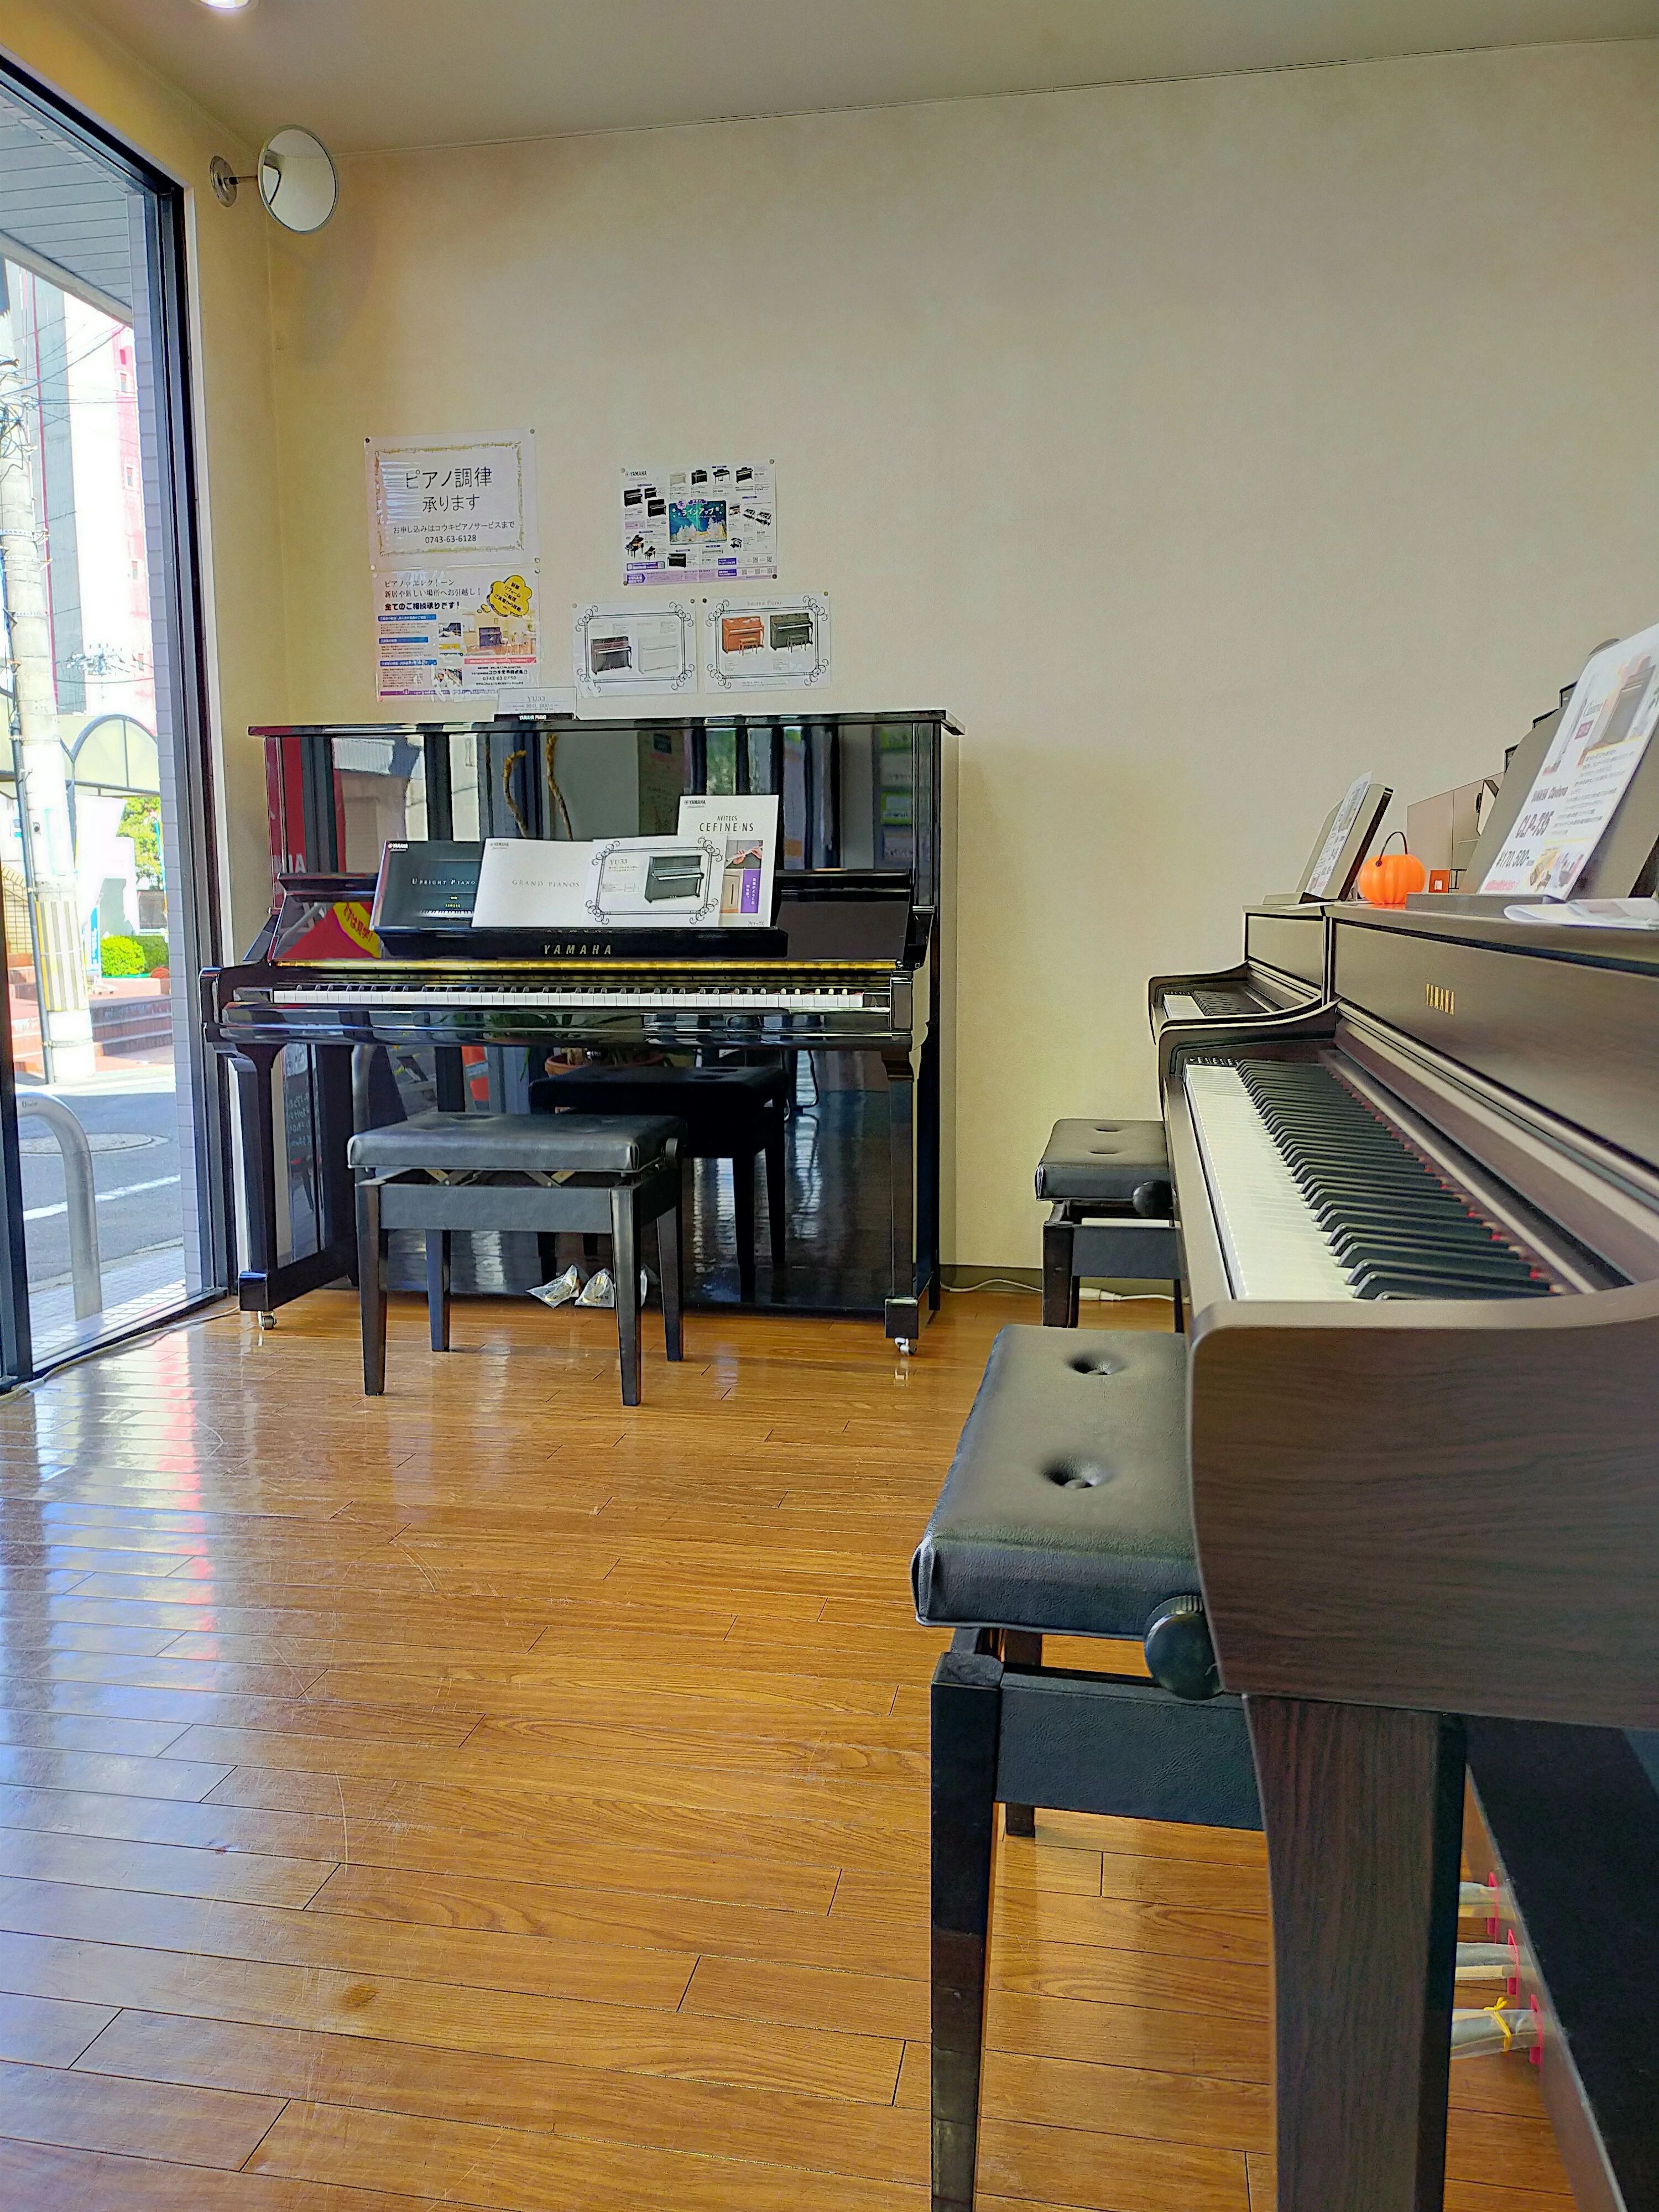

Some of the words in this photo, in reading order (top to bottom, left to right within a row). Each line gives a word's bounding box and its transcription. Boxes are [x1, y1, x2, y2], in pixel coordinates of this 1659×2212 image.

[405, 466, 492, 489] ピアノ調律
[422, 493, 481, 513] 承ります
[681, 507, 714, 517] ラインアップ
[393, 520, 515, 534] お申し込みはコウキピアノサービスまで
[425, 534, 477, 544] 0743-63-6128
[1515, 810, 1556, 839] CLP-735
[544, 945, 611, 955] YAMAHA
[1426, 983, 1454, 1015] YAMAHA
